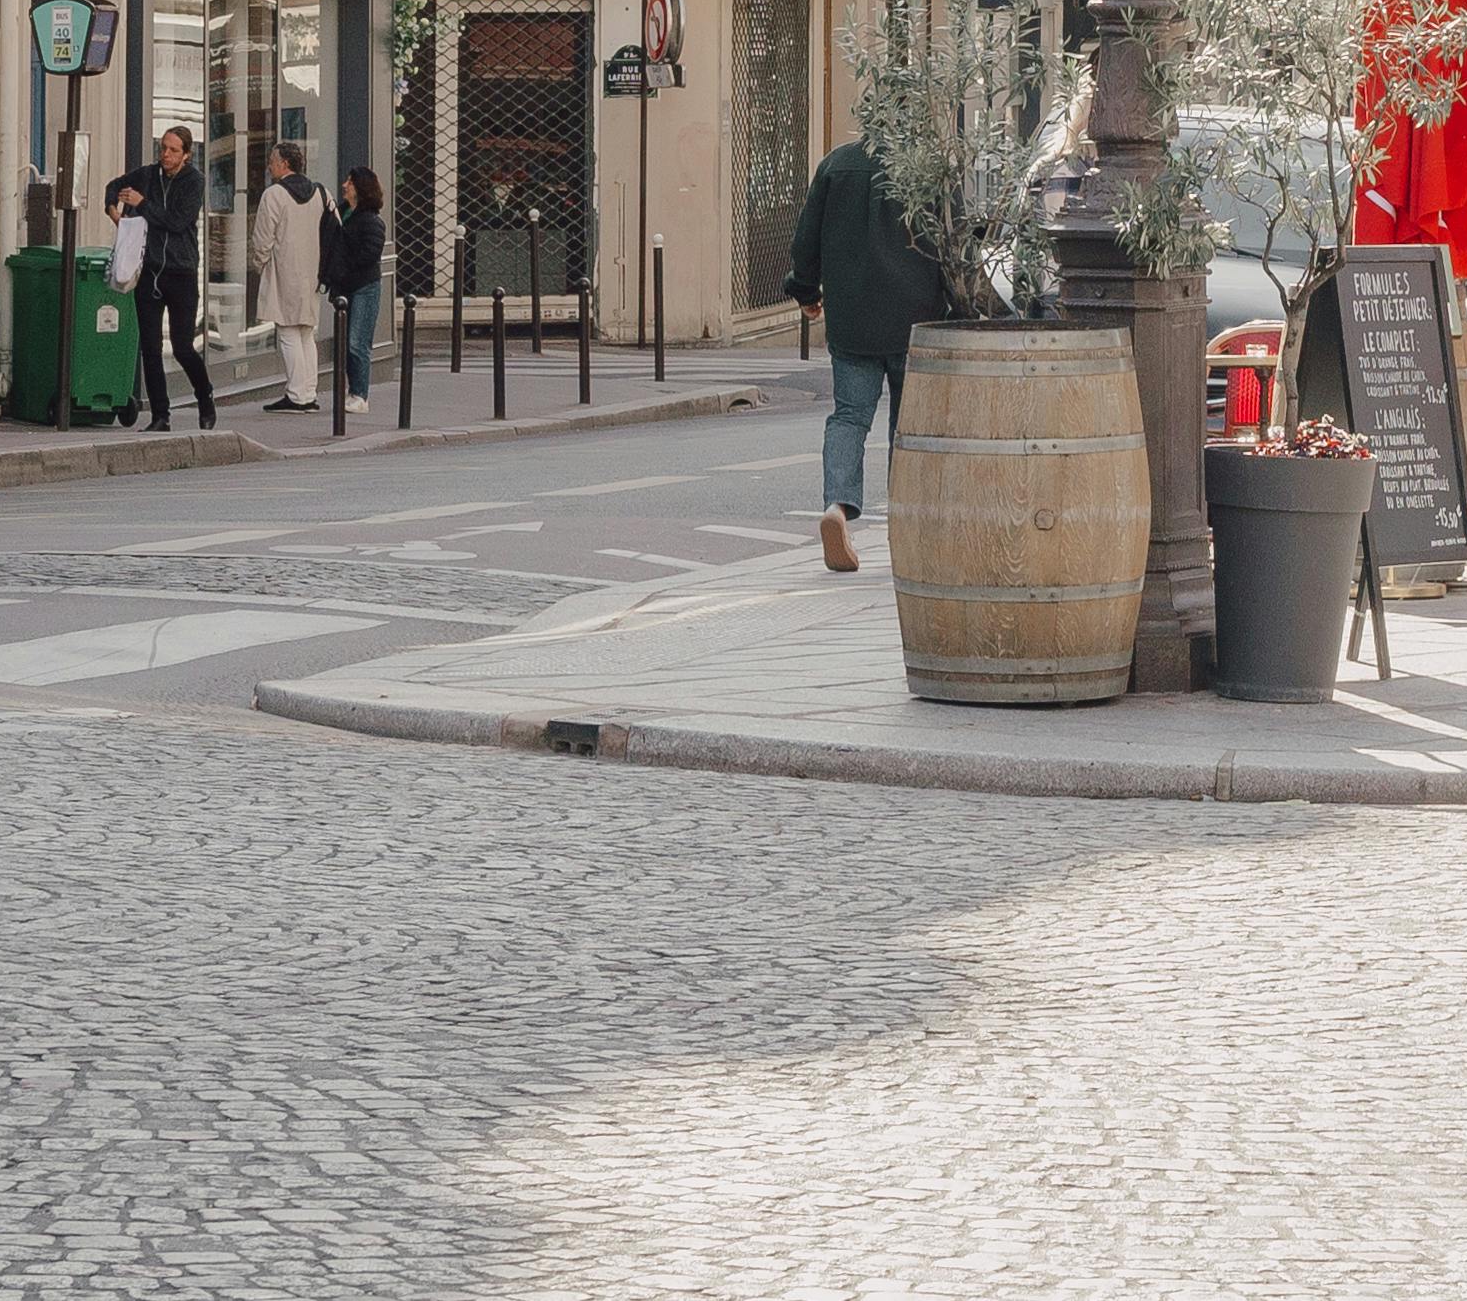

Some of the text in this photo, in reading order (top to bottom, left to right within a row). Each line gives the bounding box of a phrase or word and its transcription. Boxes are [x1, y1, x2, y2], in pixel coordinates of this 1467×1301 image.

[55, 27, 70, 38] 40
[54, 46, 70, 57] 74
[622, 65, 639, 73] RUE
[1354, 272, 1411, 296] FORMULES
